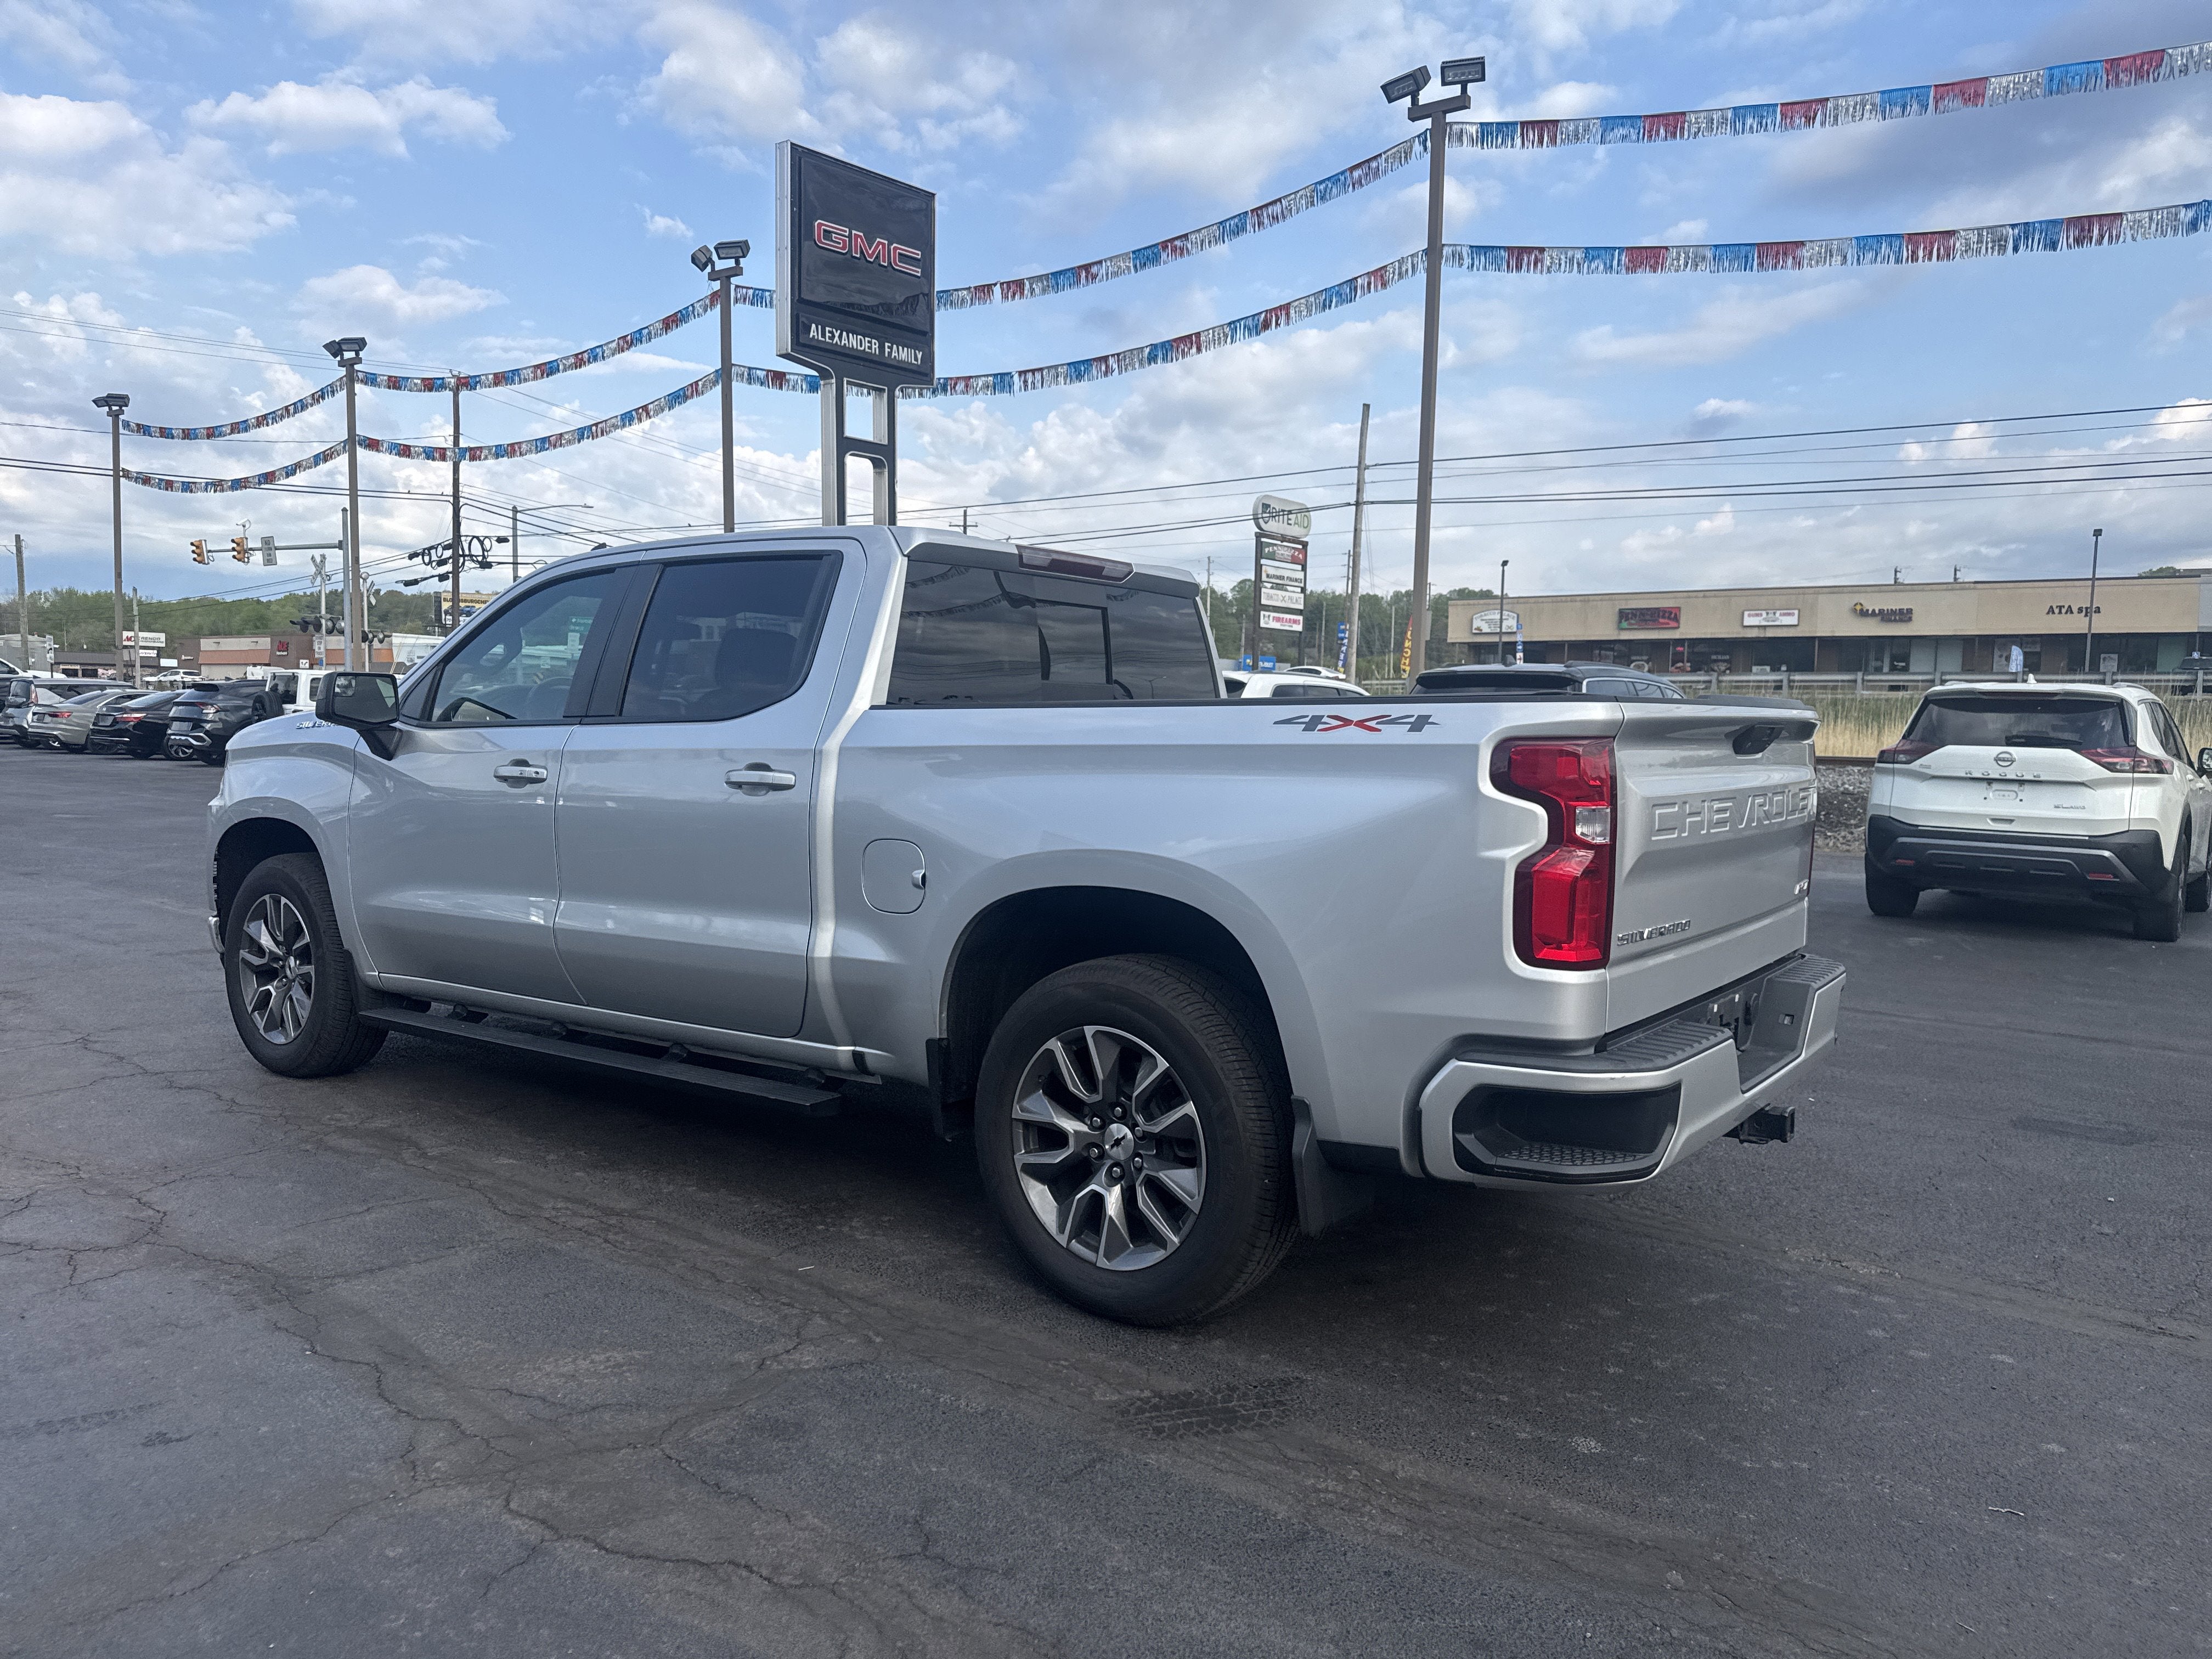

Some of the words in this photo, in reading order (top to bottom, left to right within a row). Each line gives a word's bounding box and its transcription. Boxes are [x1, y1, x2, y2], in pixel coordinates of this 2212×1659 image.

[815, 220, 921, 276] GMC
[809, 324, 879, 355] ALEXANDER
[885, 342, 922, 365] FAMILY
[1272, 506, 1292, 526] RITE
[1293, 514, 1309, 528] AID
[1266, 573, 1285, 582] MARINER
[1286, 575, 1302, 584] FINANCE
[1272, 616, 1301, 625] FIREARMS
[1859, 607, 1913, 616] MARINER
[2046, 605, 2074, 615] ATA
[2077, 606, 2101, 617] spa
[1651, 786, 1817, 840] CHEVROLET
[1617, 919, 1691, 946] SILVERADO
